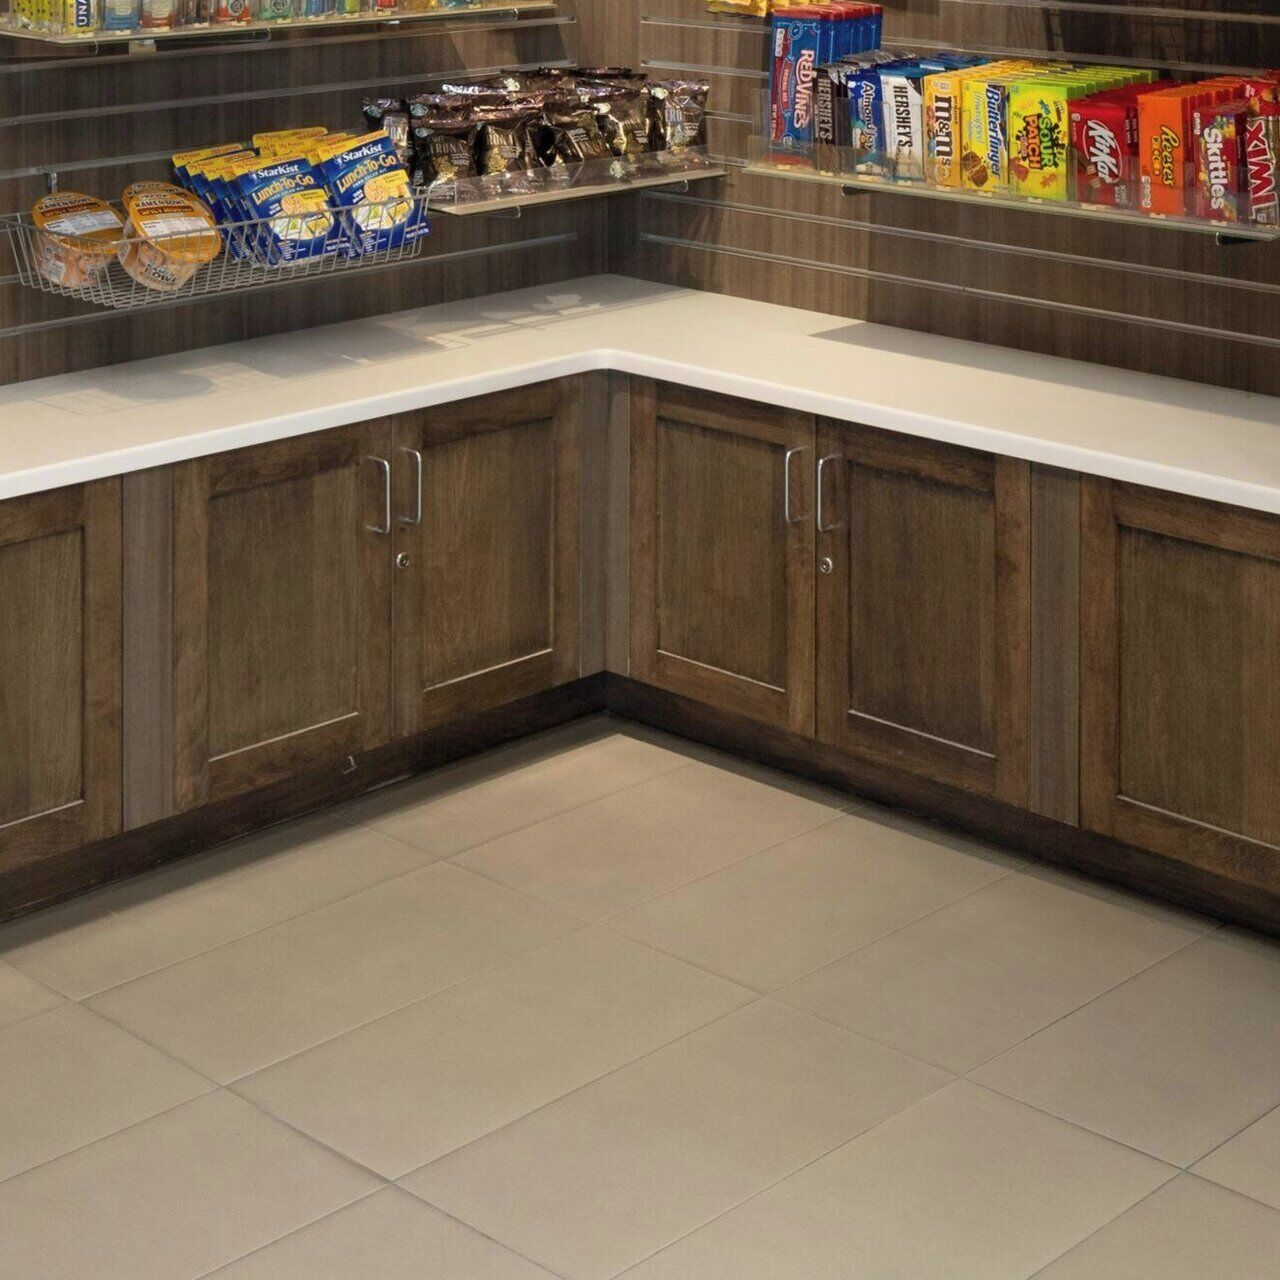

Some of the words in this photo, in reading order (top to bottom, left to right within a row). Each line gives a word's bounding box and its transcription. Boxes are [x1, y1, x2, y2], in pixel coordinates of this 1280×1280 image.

[795, 50, 816, 82] RED
[793, 83, 815, 129] VINES
[818, 77, 833, 141] HERSHEY'S
[861, 81, 877, 131] Almond
[893, 85, 913, 148] HERSHEY'S
[985, 86, 1002, 177] Butterfinger
[342, 143, 383, 163] StarKist
[1024, 114, 1041, 169] PATCH
[1039, 117, 1055, 168] SOUR
[1203, 126, 1228, 210] Skittles
[1246, 120, 1279, 207] TWIX
[258, 164, 300, 179] StarKist
